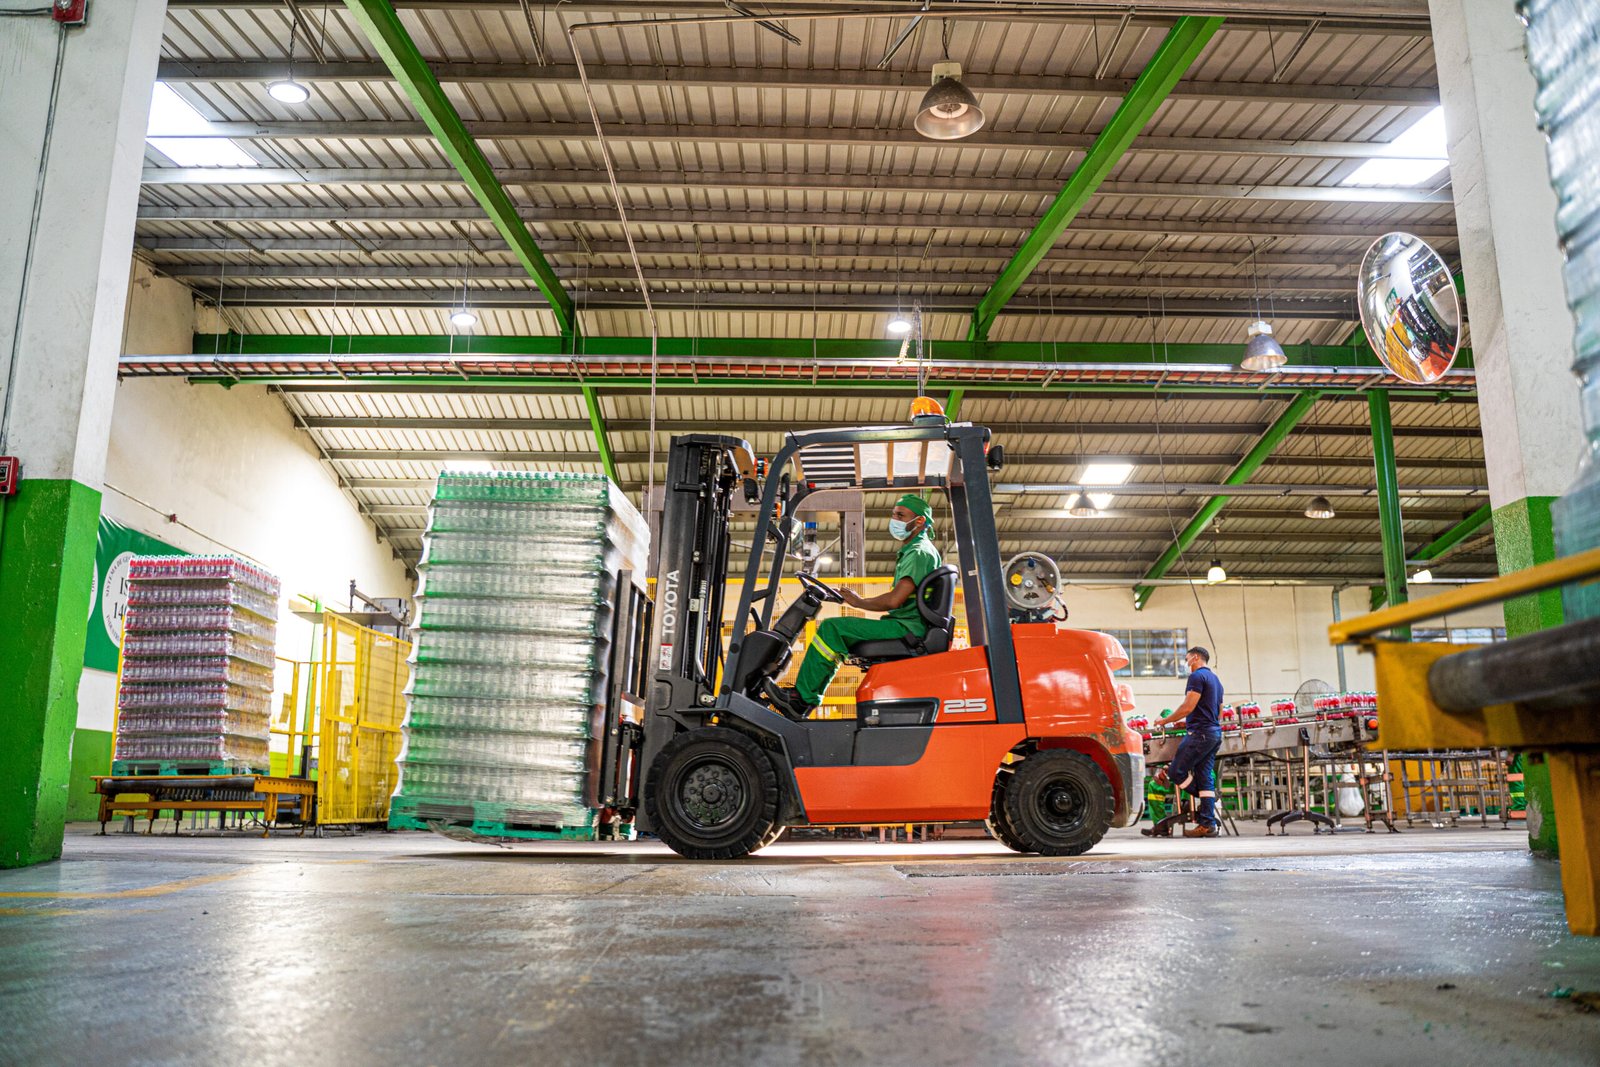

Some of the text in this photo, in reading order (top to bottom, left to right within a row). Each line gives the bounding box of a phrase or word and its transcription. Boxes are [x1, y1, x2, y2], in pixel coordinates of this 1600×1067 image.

[119, 577, 128, 596] IS
[662, 569, 680, 637] TOYOTA
[944, 698, 987, 714] 25
